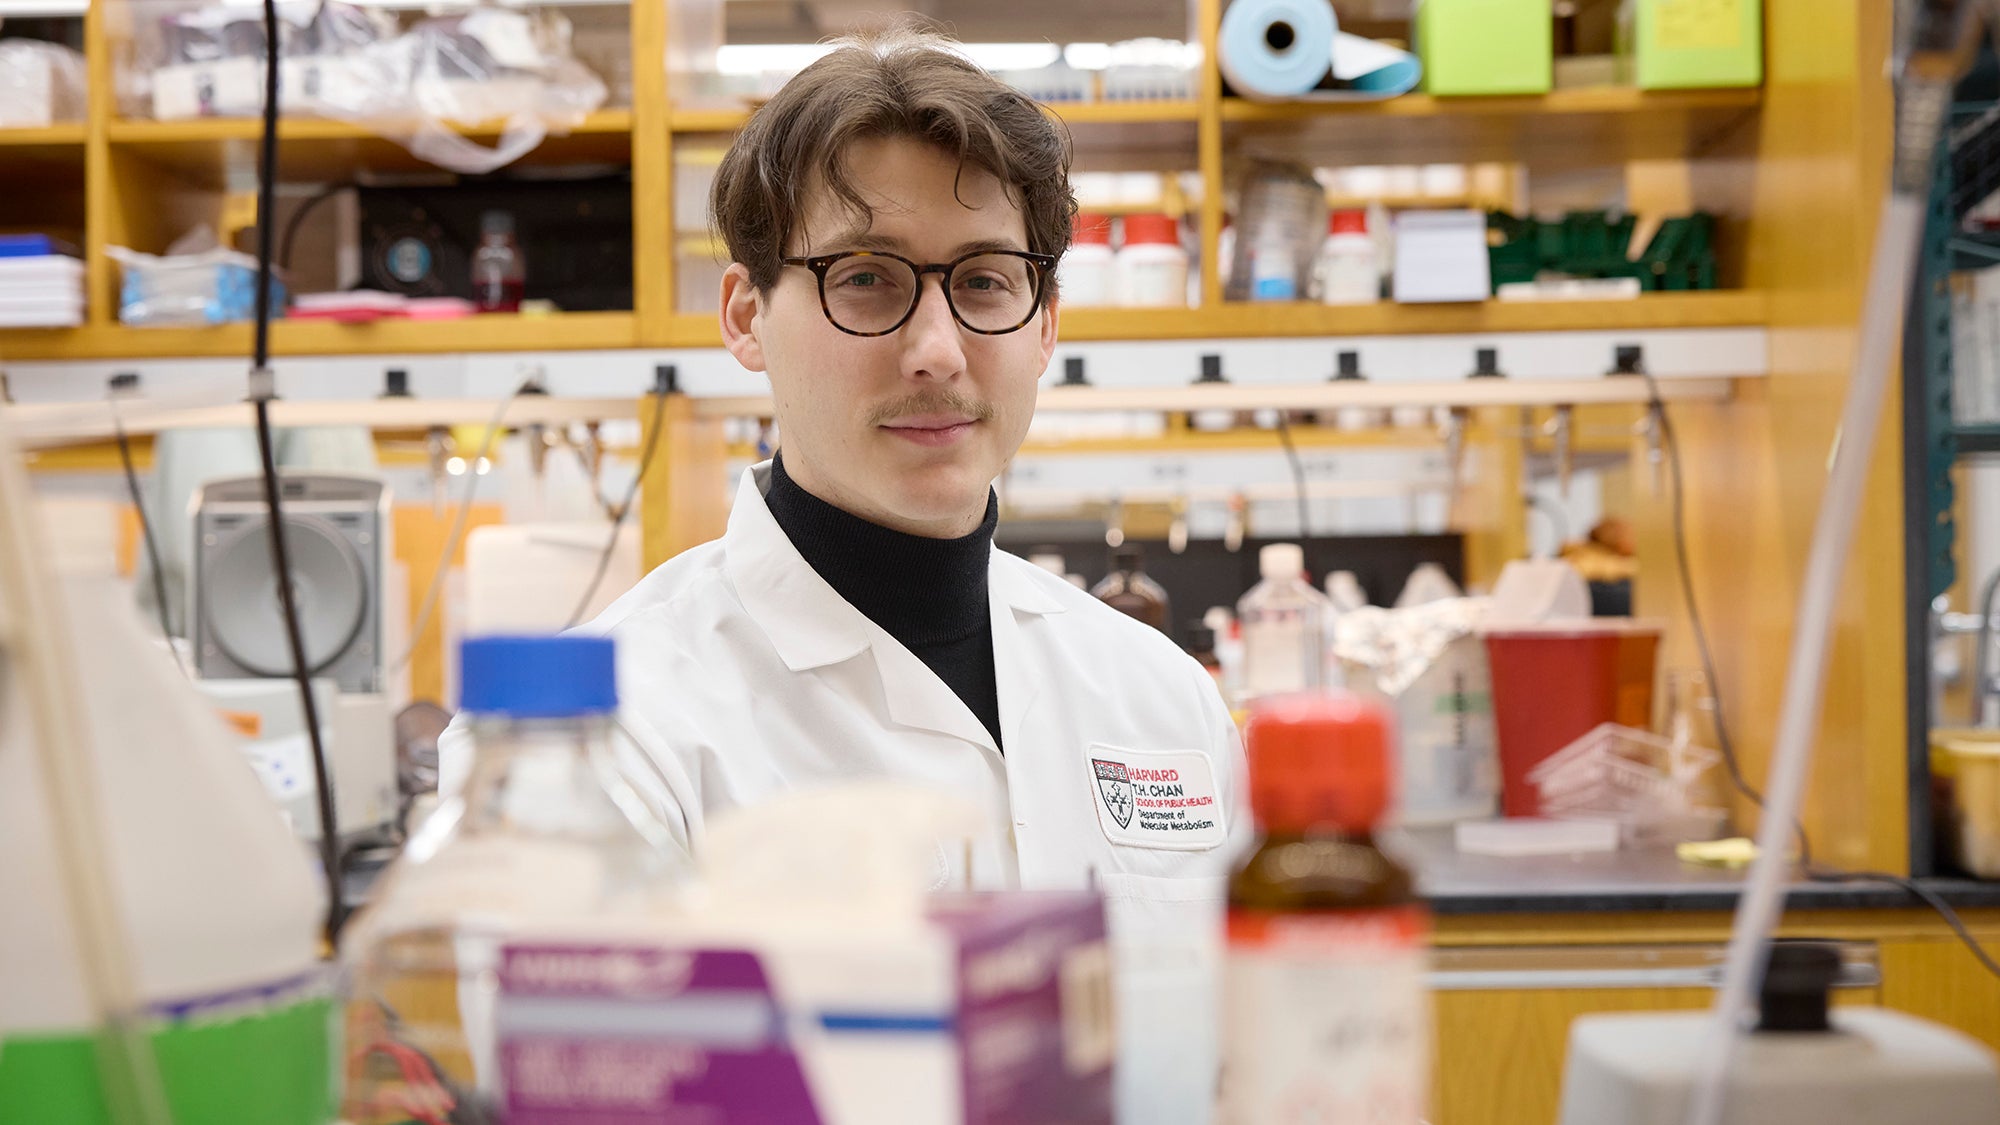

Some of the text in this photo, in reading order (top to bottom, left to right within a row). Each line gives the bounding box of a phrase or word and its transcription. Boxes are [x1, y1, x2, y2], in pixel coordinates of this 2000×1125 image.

[1128, 768, 1179, 782] HARVARD
[1132, 784, 1184, 797] T.H. CHAN
[1135, 797, 1213, 808] SCHOOL OF PUBLIC HEALTH
[1138, 809, 1185, 820] Department of
[1140, 820, 1214, 831] Molecular Metabolism
